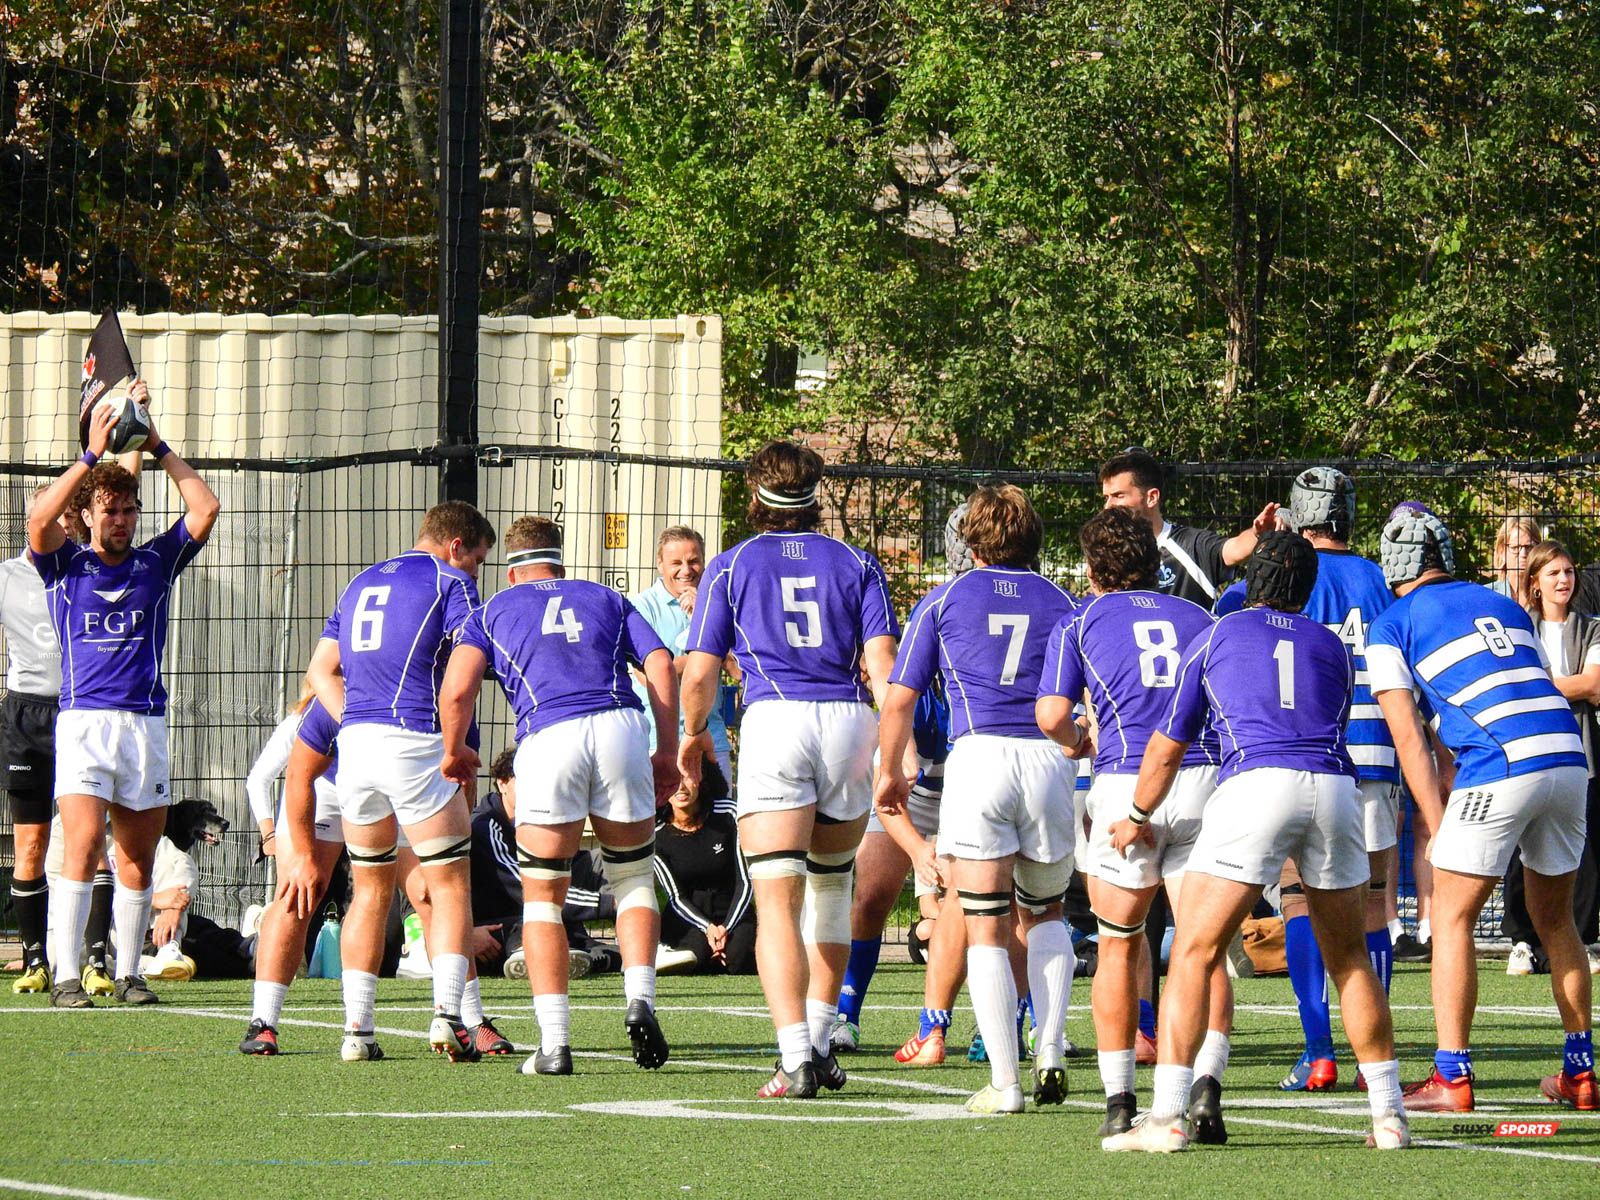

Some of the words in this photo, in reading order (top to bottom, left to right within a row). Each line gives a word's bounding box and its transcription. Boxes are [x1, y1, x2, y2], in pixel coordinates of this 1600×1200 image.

[83, 610, 145, 635] FGP
[351, 585, 391, 653] 6
[541, 596, 583, 643] 4
[780, 576, 823, 648] 5
[1337, 606, 1365, 656] 4
[1473, 616, 1516, 658] 8
[988, 613, 1030, 686] 7
[1132, 620, 1181, 688] 8
[1272, 639, 1295, 710] 1
